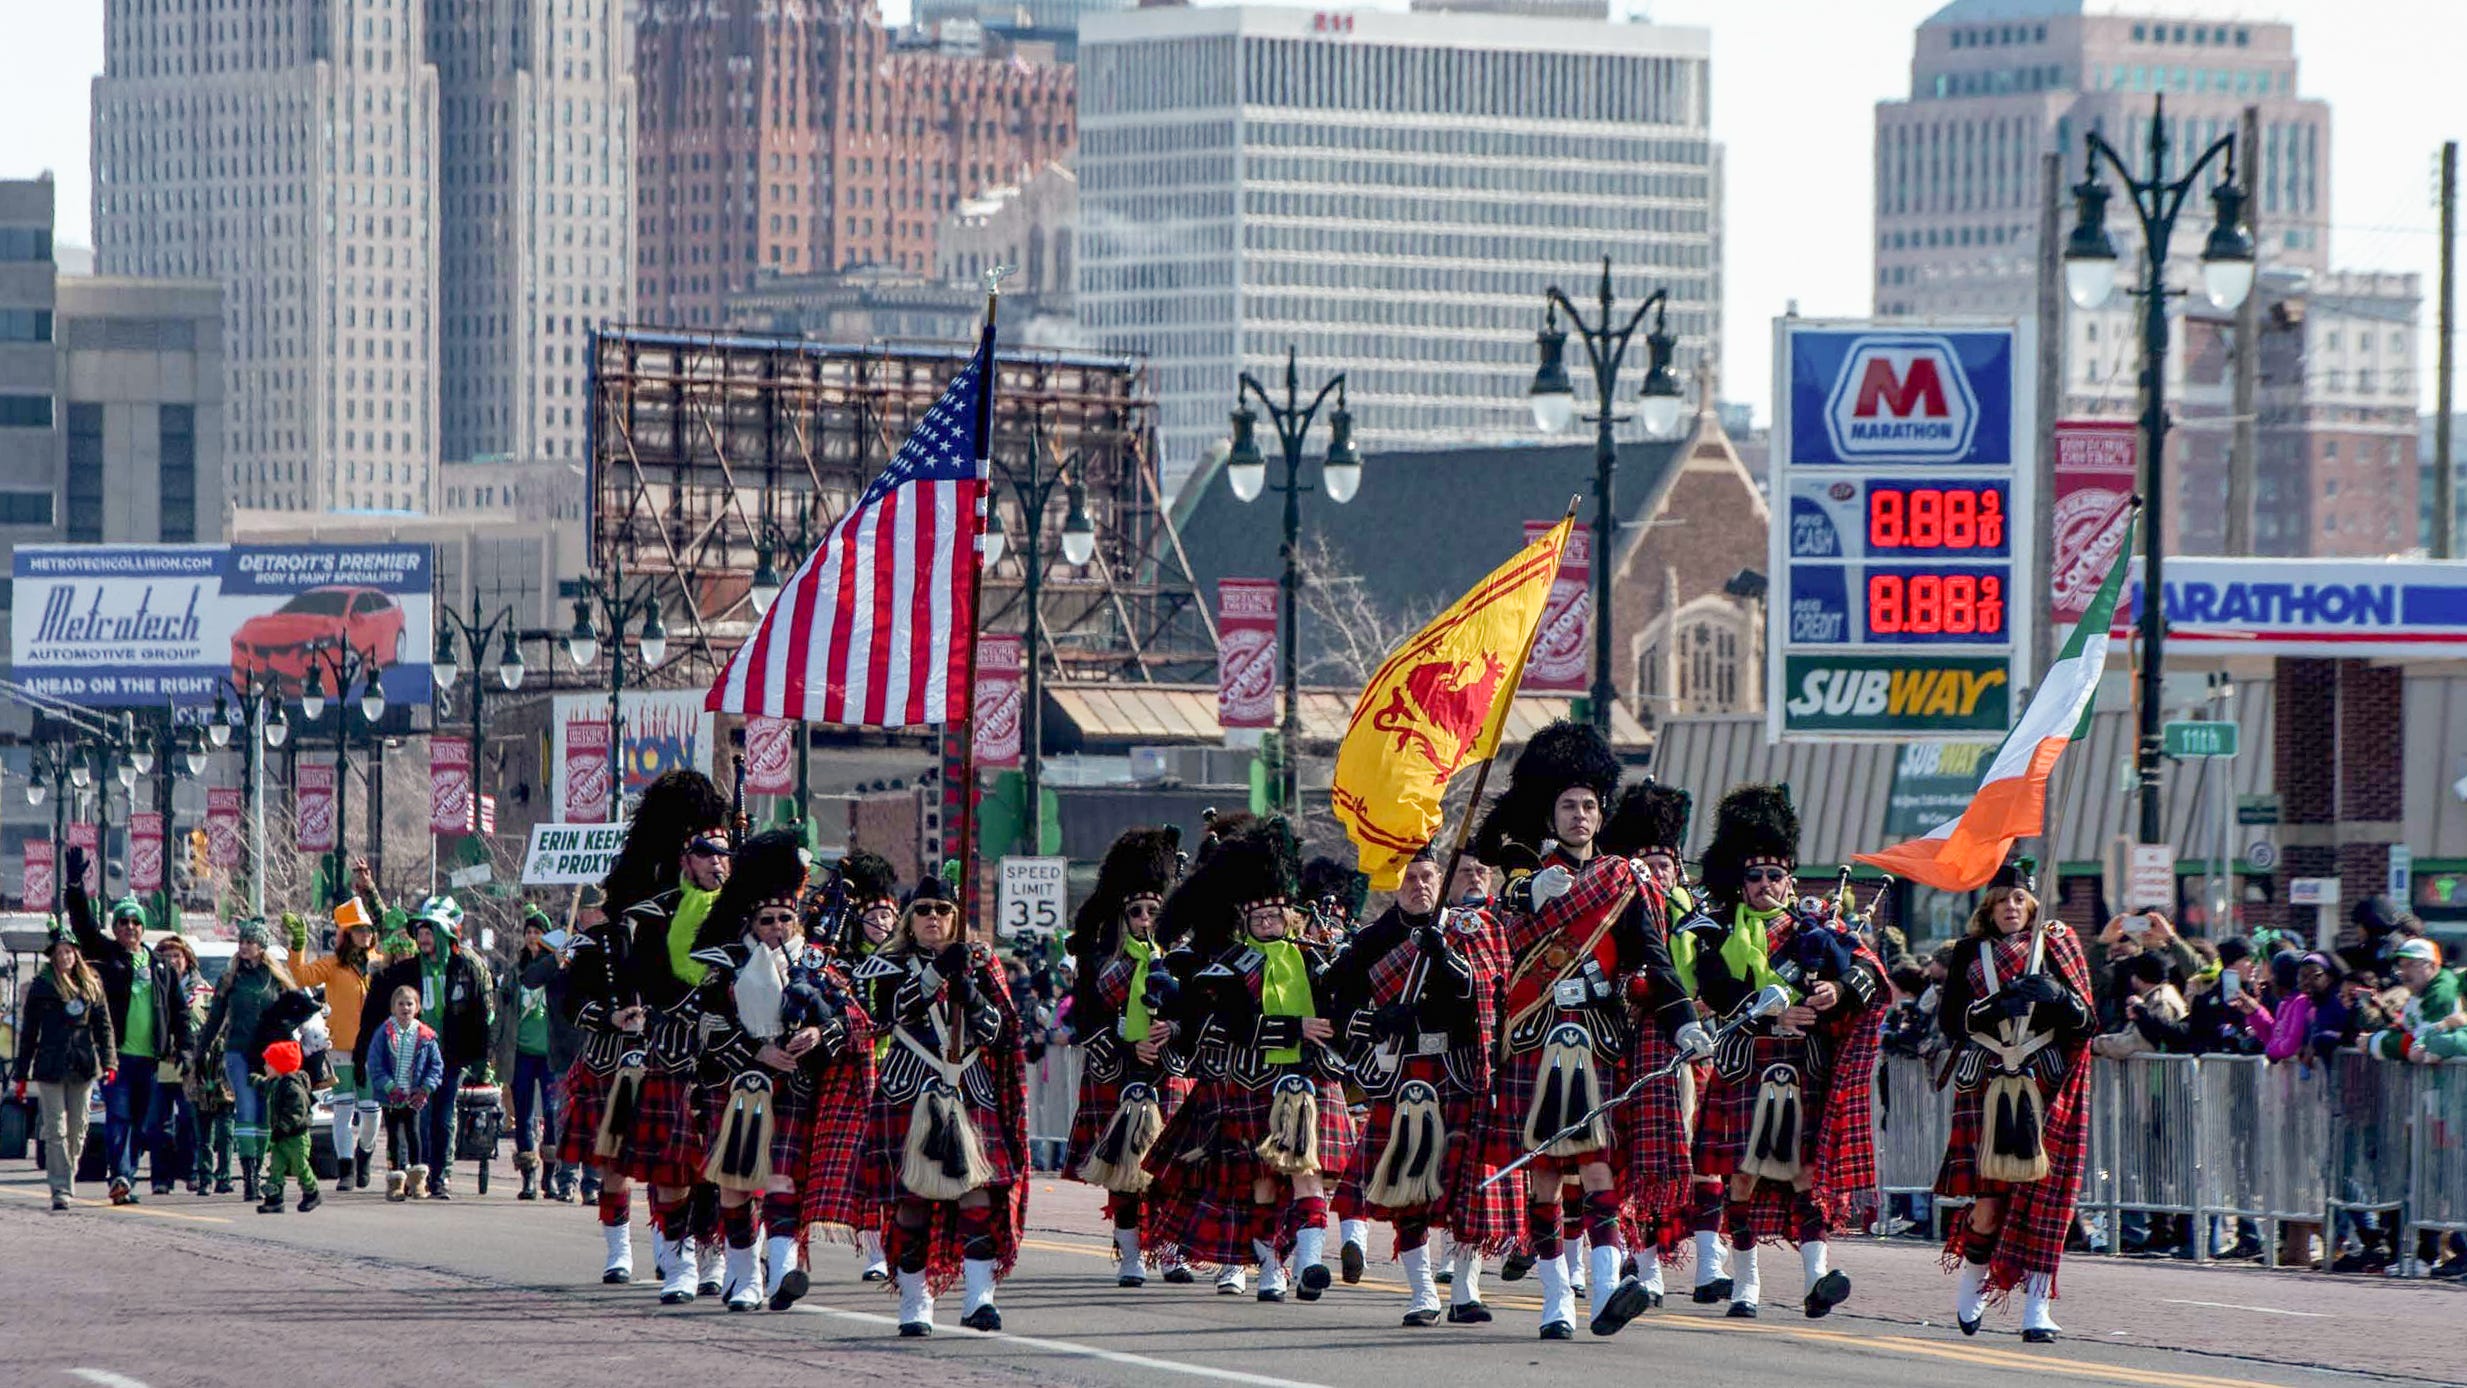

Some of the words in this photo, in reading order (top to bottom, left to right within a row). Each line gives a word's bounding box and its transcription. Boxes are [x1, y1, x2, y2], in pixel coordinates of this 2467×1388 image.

[1851, 423, 1953, 440] MARATHON
[30, 557, 213, 571] METROTECHCOLLISION.COM
[239, 554, 335, 572] DETROIT'S
[340, 553, 421, 571] PREMIER
[255, 573, 287, 584] BODY
[298, 573, 330, 584] PAINT
[334, 572, 403, 584] SPECIALISTS
[31, 584, 200, 643] Metrotech
[28, 648, 135, 661] AUTOMOTIVE
[141, 648, 200, 661] GROUP
[24, 677, 86, 694] AHEAD
[90, 677, 115, 693] ON
[120, 677, 155, 693] THE
[161, 677, 214, 694] RIGHT
[1788, 668, 2007, 718] SUBWAY
[2181, 728, 2221, 753] 11th
[1899, 742, 1997, 776] SUBWAY
[538, 831, 580, 852] ERIN
[1006, 866, 1060, 879] SPEED
[1012, 883, 1054, 897] LIMIT
[1010, 900, 1057, 928] 35
